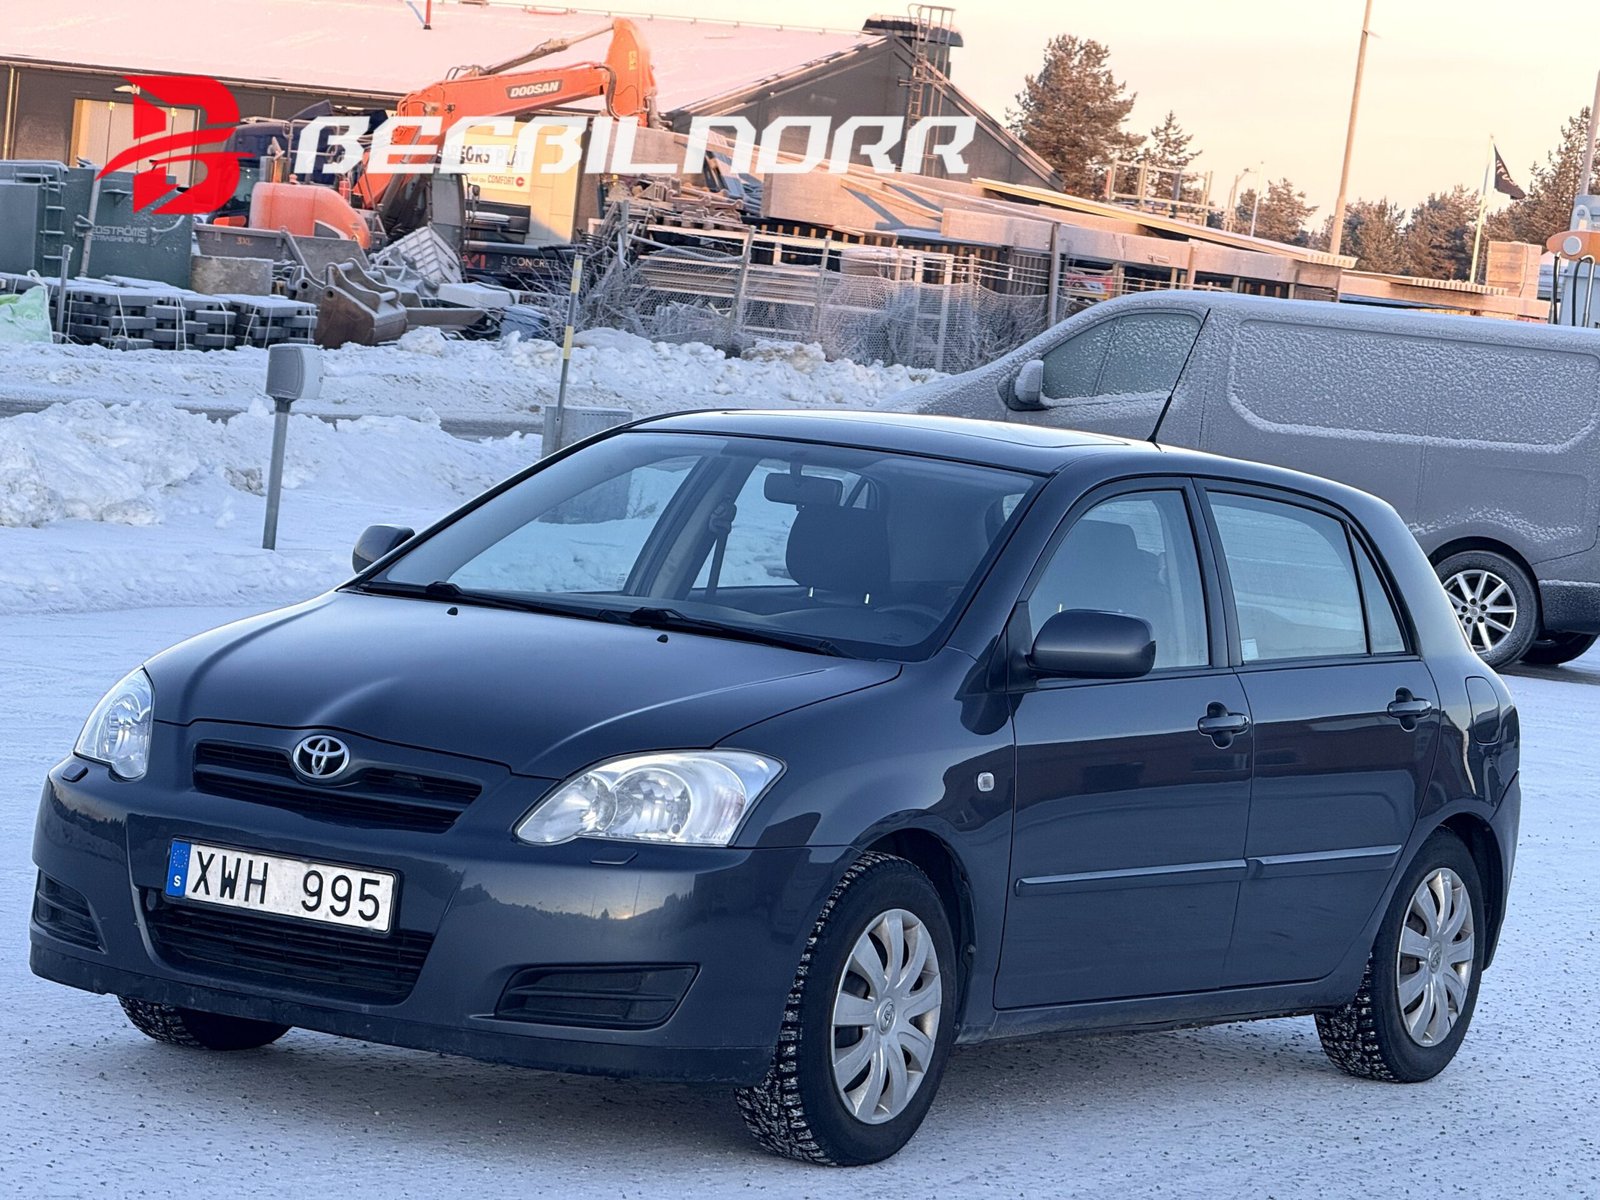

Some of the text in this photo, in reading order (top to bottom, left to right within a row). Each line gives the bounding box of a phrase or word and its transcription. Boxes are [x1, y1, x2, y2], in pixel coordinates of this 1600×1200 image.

[510, 81, 560, 98] DOOSAN
[488, 175, 515, 185] COMFORT
[173, 875, 182, 887] S
[192, 851, 380, 921] XWH 995
